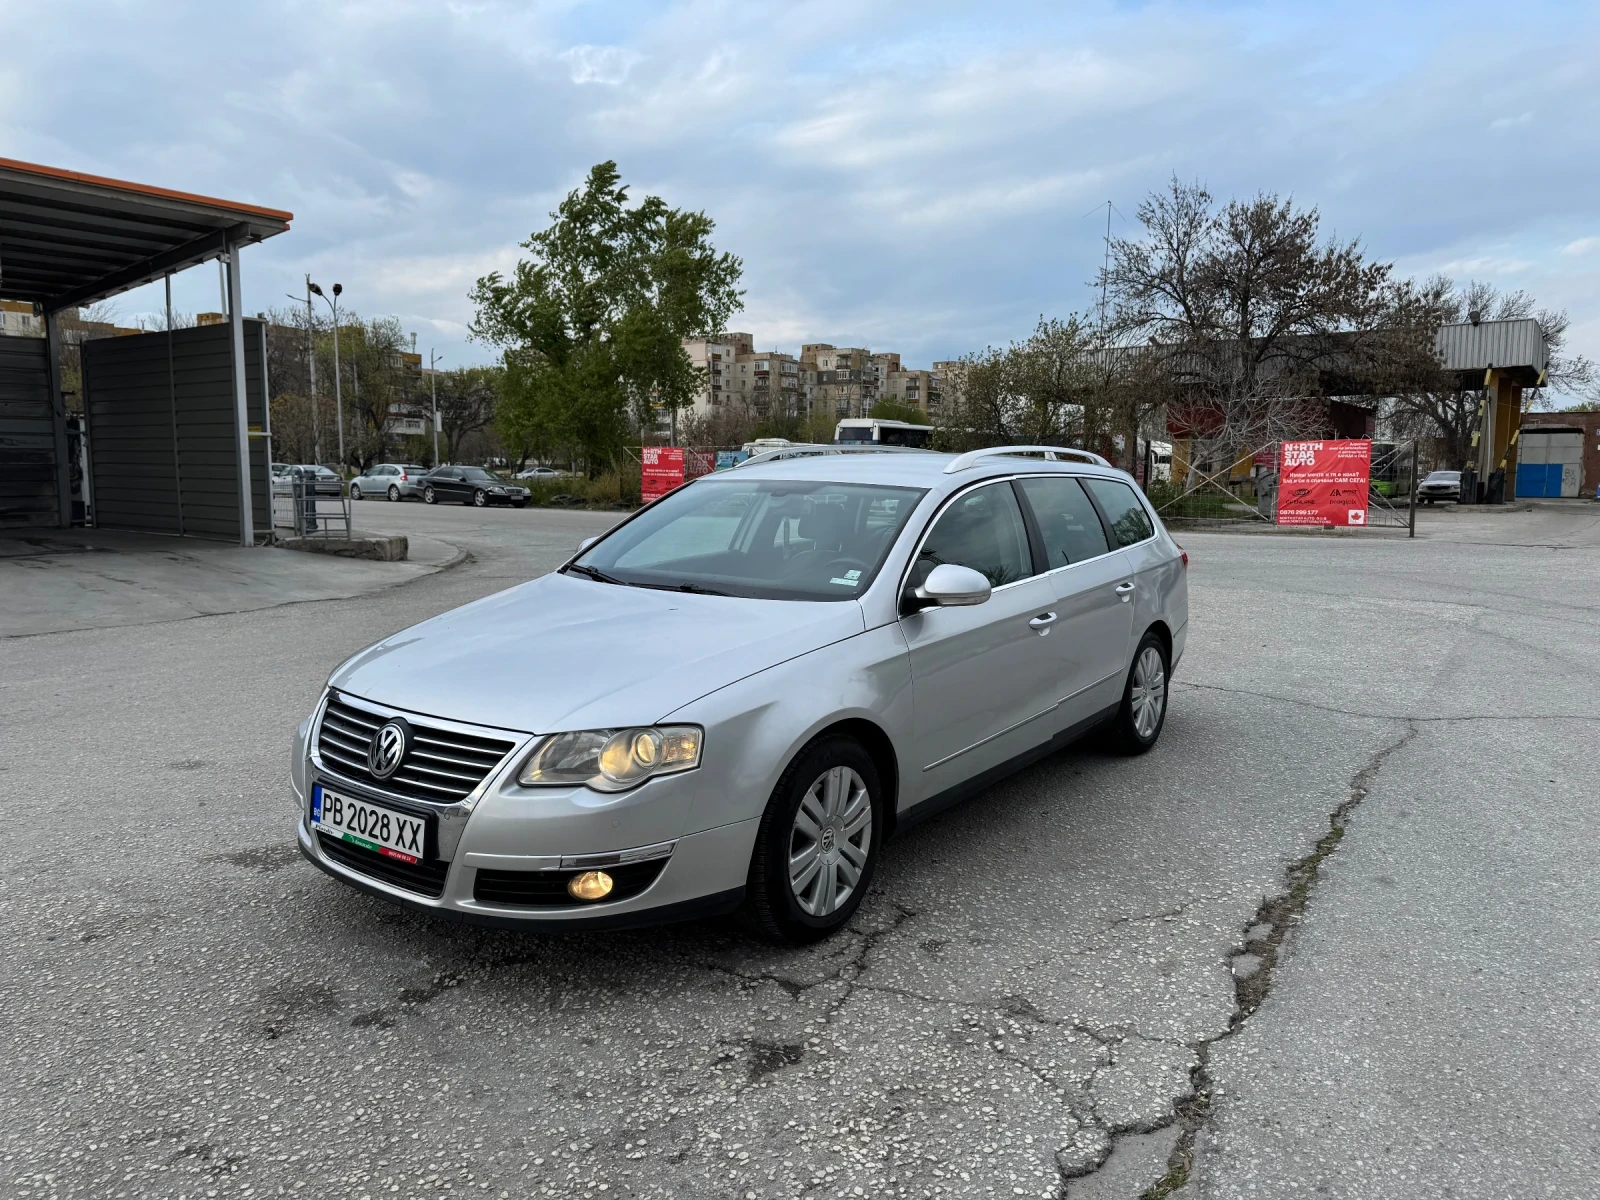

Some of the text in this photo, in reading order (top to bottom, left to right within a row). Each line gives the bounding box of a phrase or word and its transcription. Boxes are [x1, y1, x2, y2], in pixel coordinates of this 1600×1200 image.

[1284, 450, 1315, 459] STAR
[1283, 458, 1315, 467] AUTO
[313, 807, 321, 818] BG
[322, 793, 422, 854] PB 2028 XX
